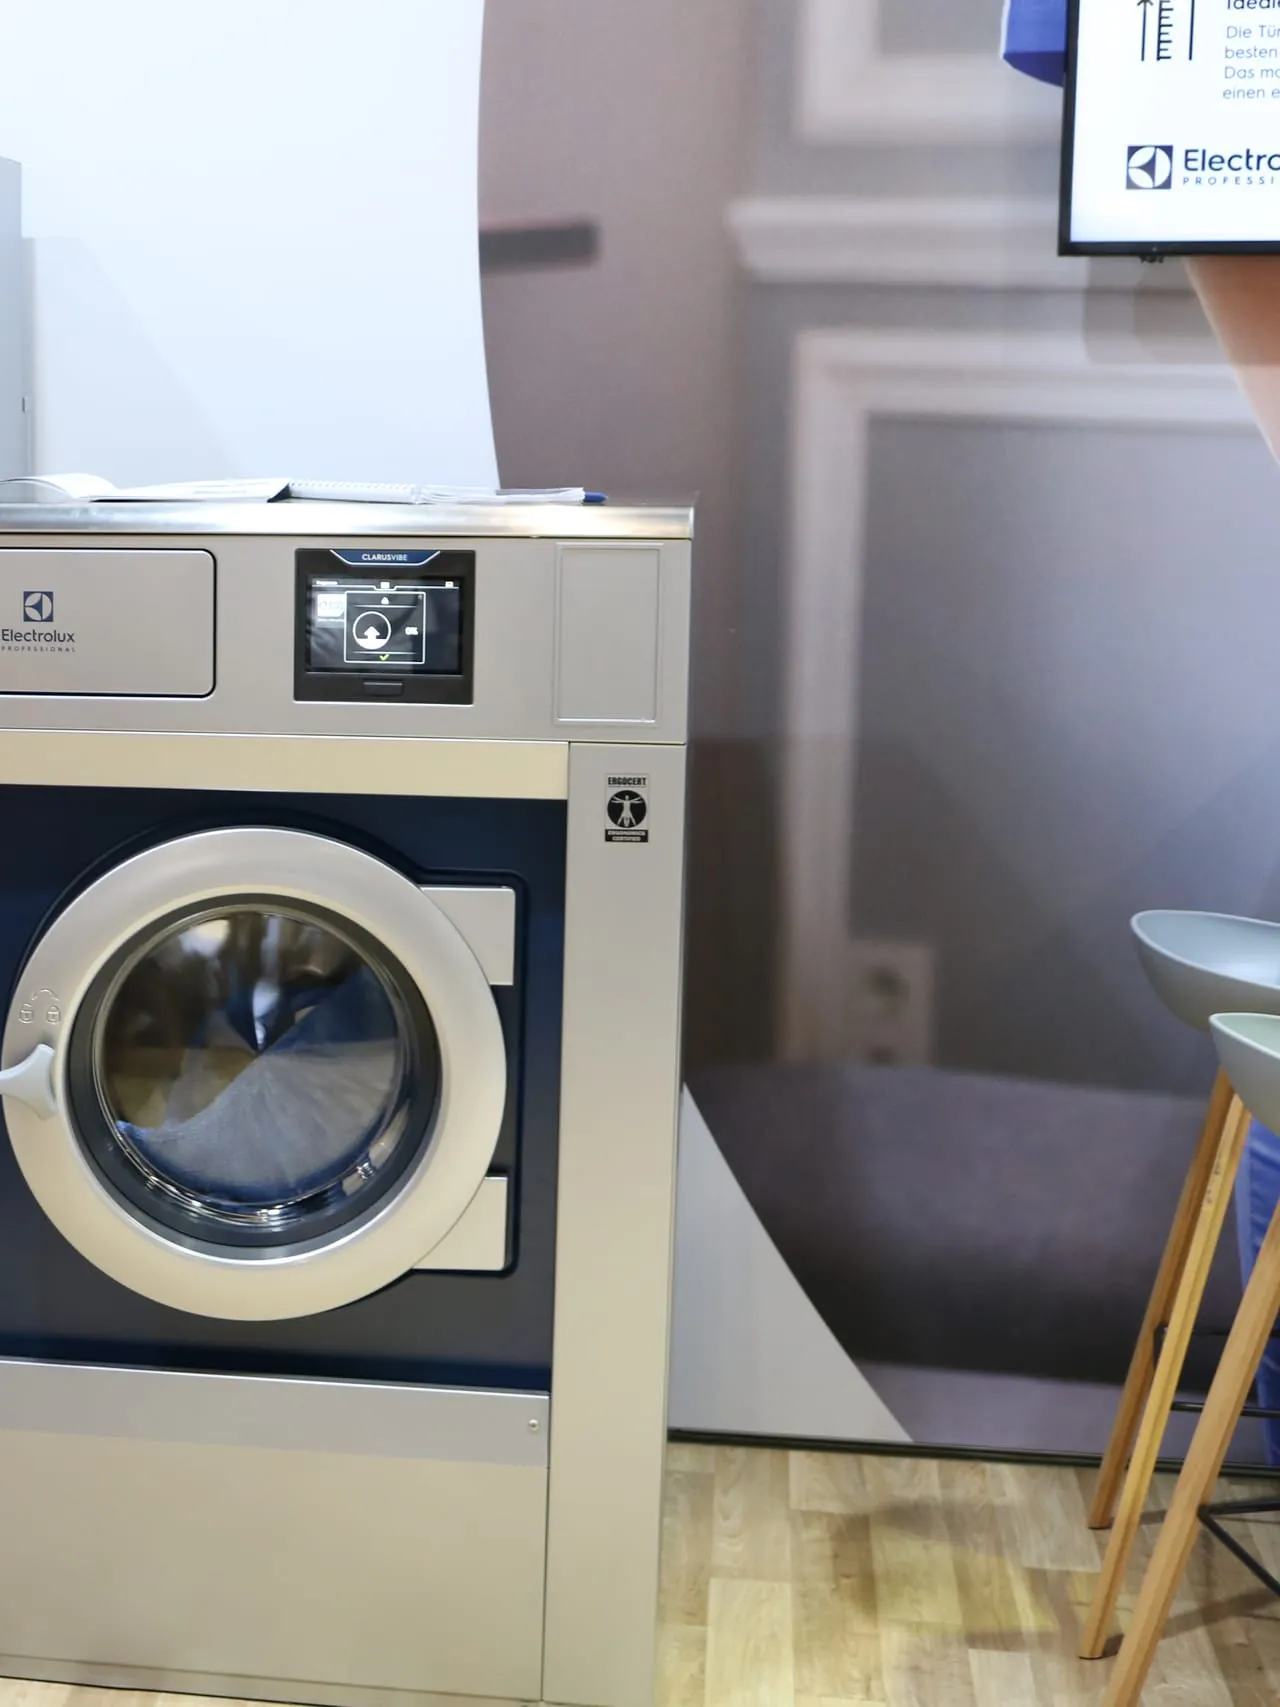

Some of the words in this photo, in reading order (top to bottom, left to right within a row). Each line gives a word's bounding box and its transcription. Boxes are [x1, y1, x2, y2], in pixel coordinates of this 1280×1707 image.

[1226, 25, 1252, 39] Die
[1224, 46, 1277, 59] besten
[1224, 66, 1255, 79] Das
[1222, 86, 1265, 99] einen
[1183, 148, 1280, 172] Electro
[1183, 176, 1274, 186] PROFESSI
[361, 553, 408, 561] CLARUSVIBE
[1, 628, 75, 643] Electrolux
